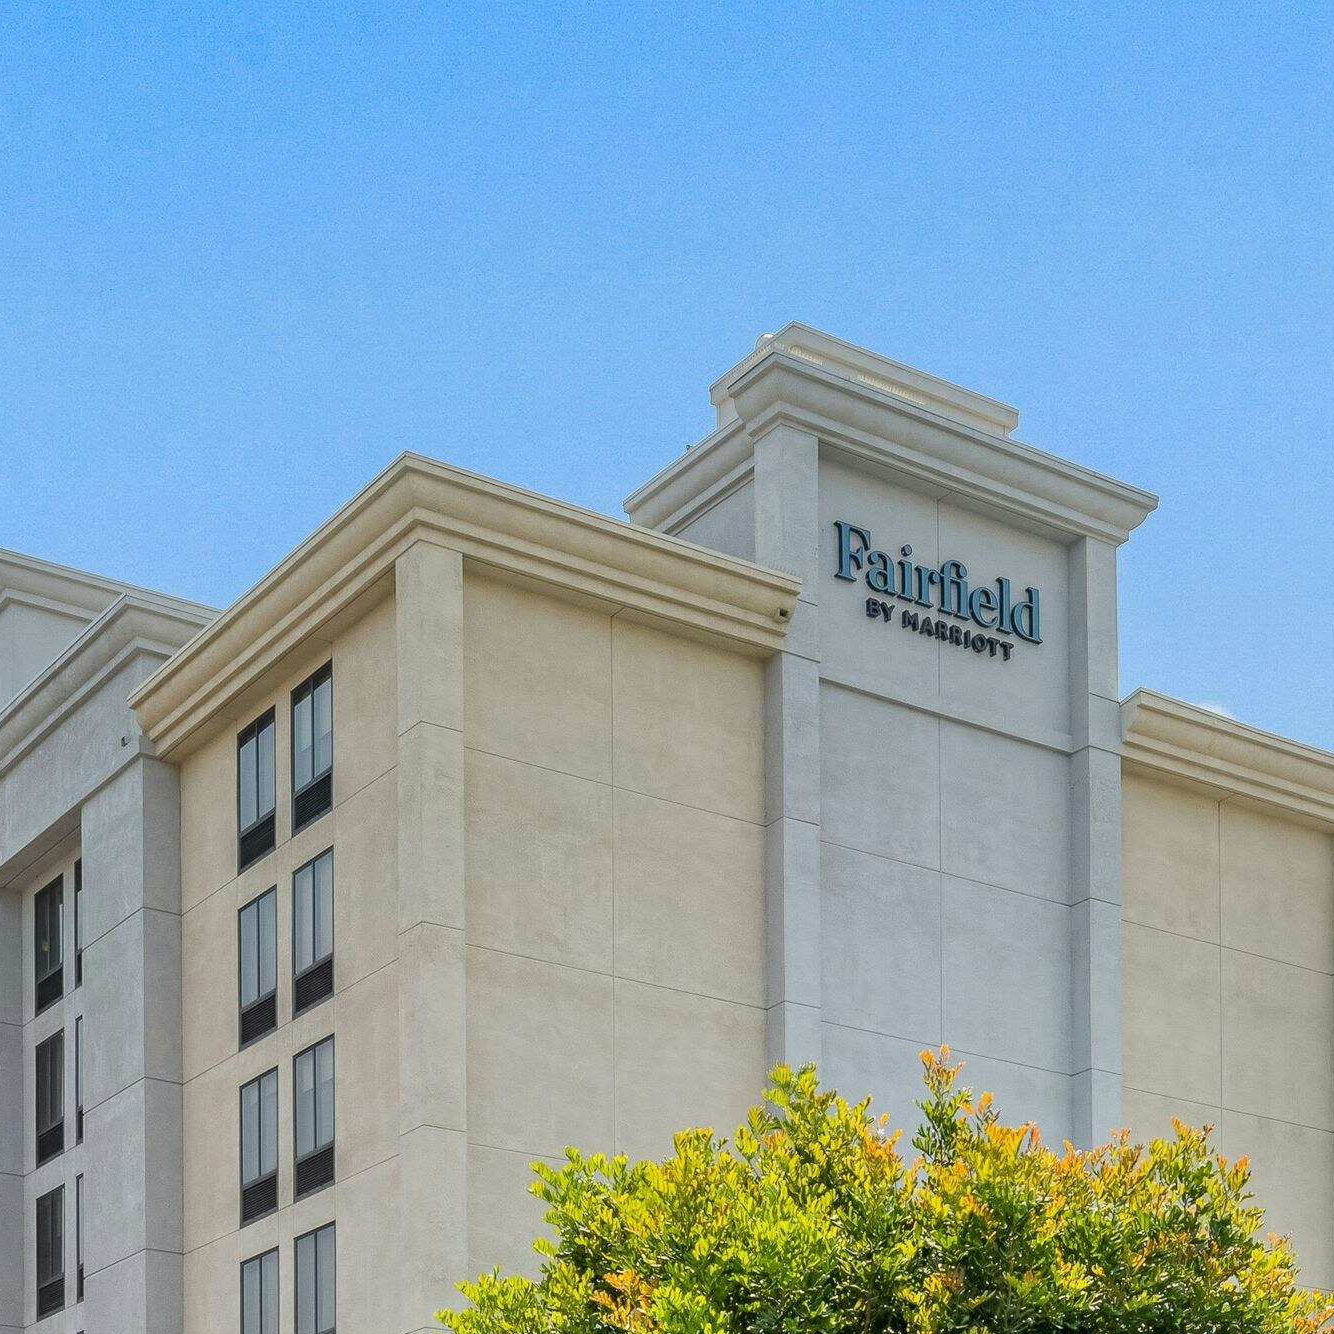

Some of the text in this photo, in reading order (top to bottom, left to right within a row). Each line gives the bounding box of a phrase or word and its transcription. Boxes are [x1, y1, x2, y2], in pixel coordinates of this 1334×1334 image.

[833, 519, 1044, 645] Fairfield
[866, 597, 1015, 662] BY MARRIOTT
